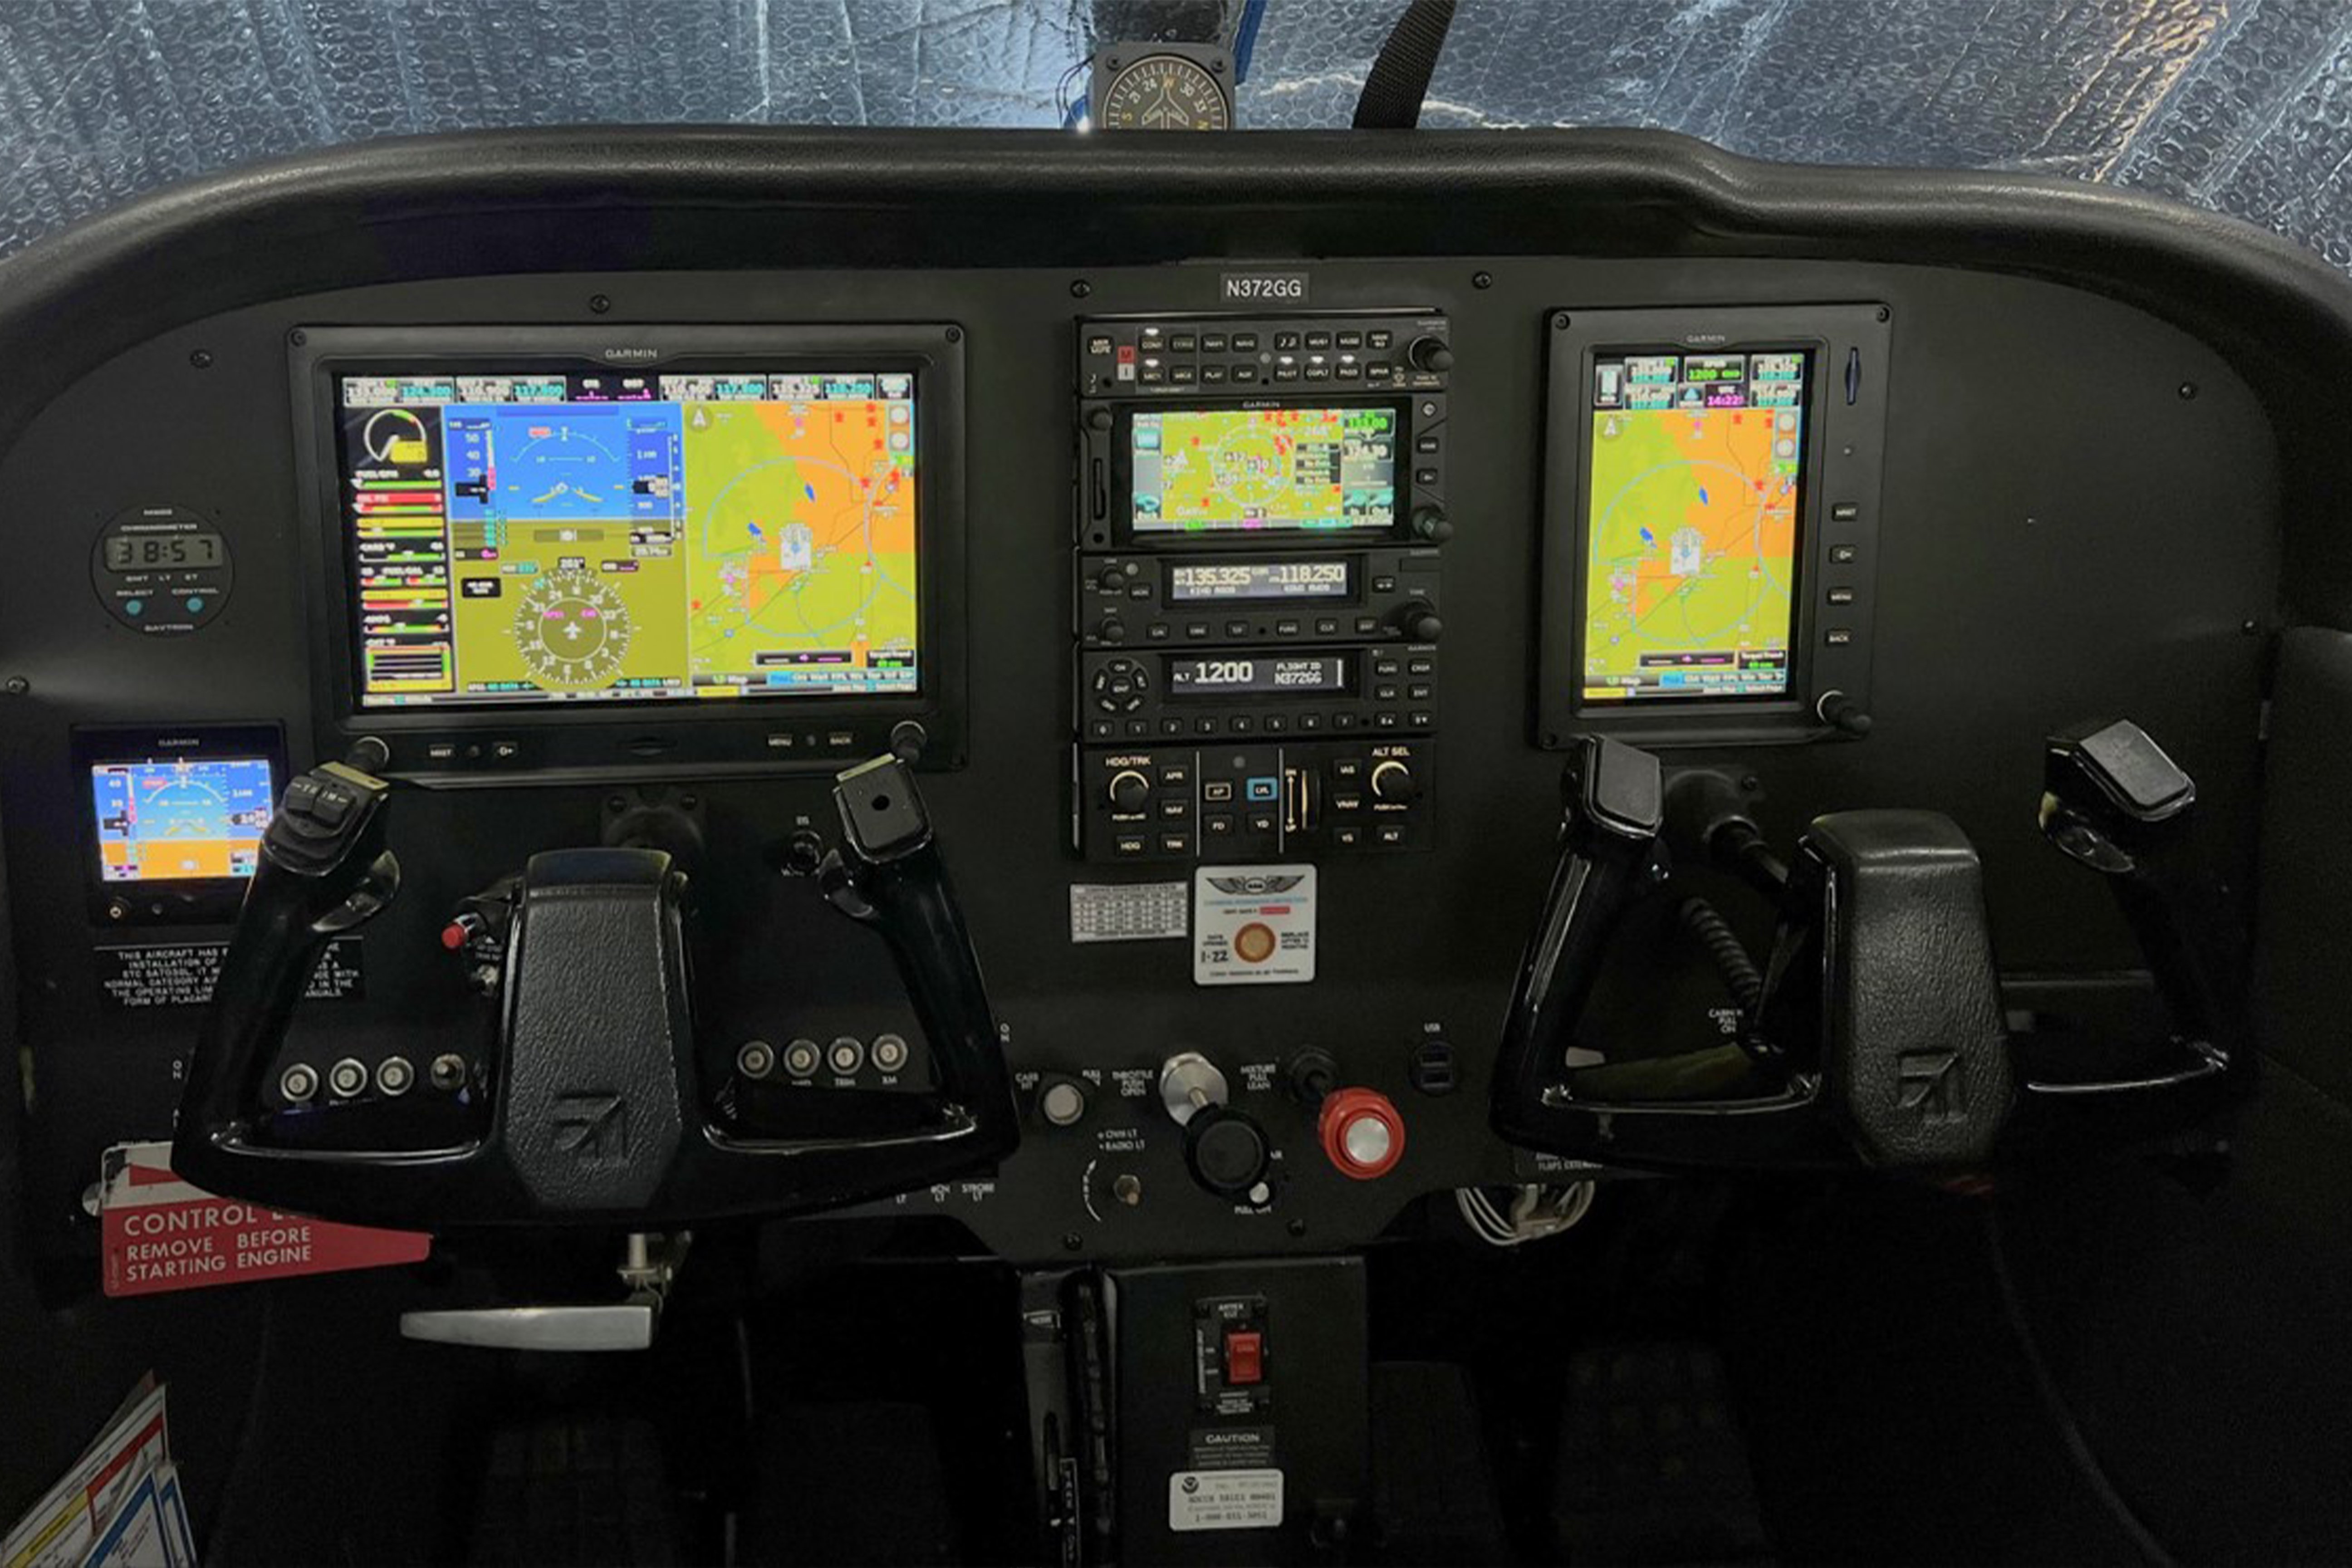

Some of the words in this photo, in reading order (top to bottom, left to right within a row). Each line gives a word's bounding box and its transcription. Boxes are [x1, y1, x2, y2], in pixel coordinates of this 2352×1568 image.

[1142, 78, 1157, 92] 24
[1180, 82, 1195, 98] 30
[1226, 280, 1302, 298] N372GG
[1686, 335, 1725, 343] GARMIN
[605, 349, 657, 358] GARMIN
[1277, 662, 1308, 671] FLIGHT
[1195, 661, 1253, 683] 1200
[1274, 672, 1322, 685] N372GG
[768, 738, 792, 746] MENU
[1372, 748, 1390, 756] ALT
[1392, 747, 1410, 756] SEL
[1106, 756, 1151, 767] HDG/TRK
[1165, 772, 1183, 780] APR
[303, 784, 337, 801] TRIM
[1256, 819, 1269, 828] YD
[1384, 832, 1398, 840] ALT
[1121, 842, 1141, 850] HDG
[118, 951, 140, 960] THIS
[146, 948, 193, 959] AIRCRAFT
[198, 948, 218, 957] HAS
[129, 958, 200, 969] INSTALLATION
[104, 979, 144, 989] NORMAL
[148, 977, 199, 987] CATEGORY
[333, 979, 353, 988] THE
[135, 986, 191, 997] OPERATING
[124, 997, 151, 1006] FORM
[1424, 1023, 1441, 1033] USB
[1240, 1063, 1276, 1074] MIXTURE
[1112, 1070, 1154, 1080] THROTTLE
[1247, 1081, 1271, 1090] LEAN
[1120, 1088, 1147, 1097] OPEN
[1106, 1140, 1134, 1151] RADIO
[1135, 1139, 1145, 1150] LT
[962, 1183, 995, 1193] STROBE
[935, 1192, 945, 1202] LT
[973, 1191, 982, 1201] LT
[124, 1205, 257, 1237] CONTROL
[126, 1235, 213, 1262] REMOVE
[236, 1226, 312, 1250] BEFORE
[126, 1255, 225, 1283] STARTING
[236, 1245, 313, 1269] ENGINE
[1205, 1432, 1260, 1444] CAUTION
